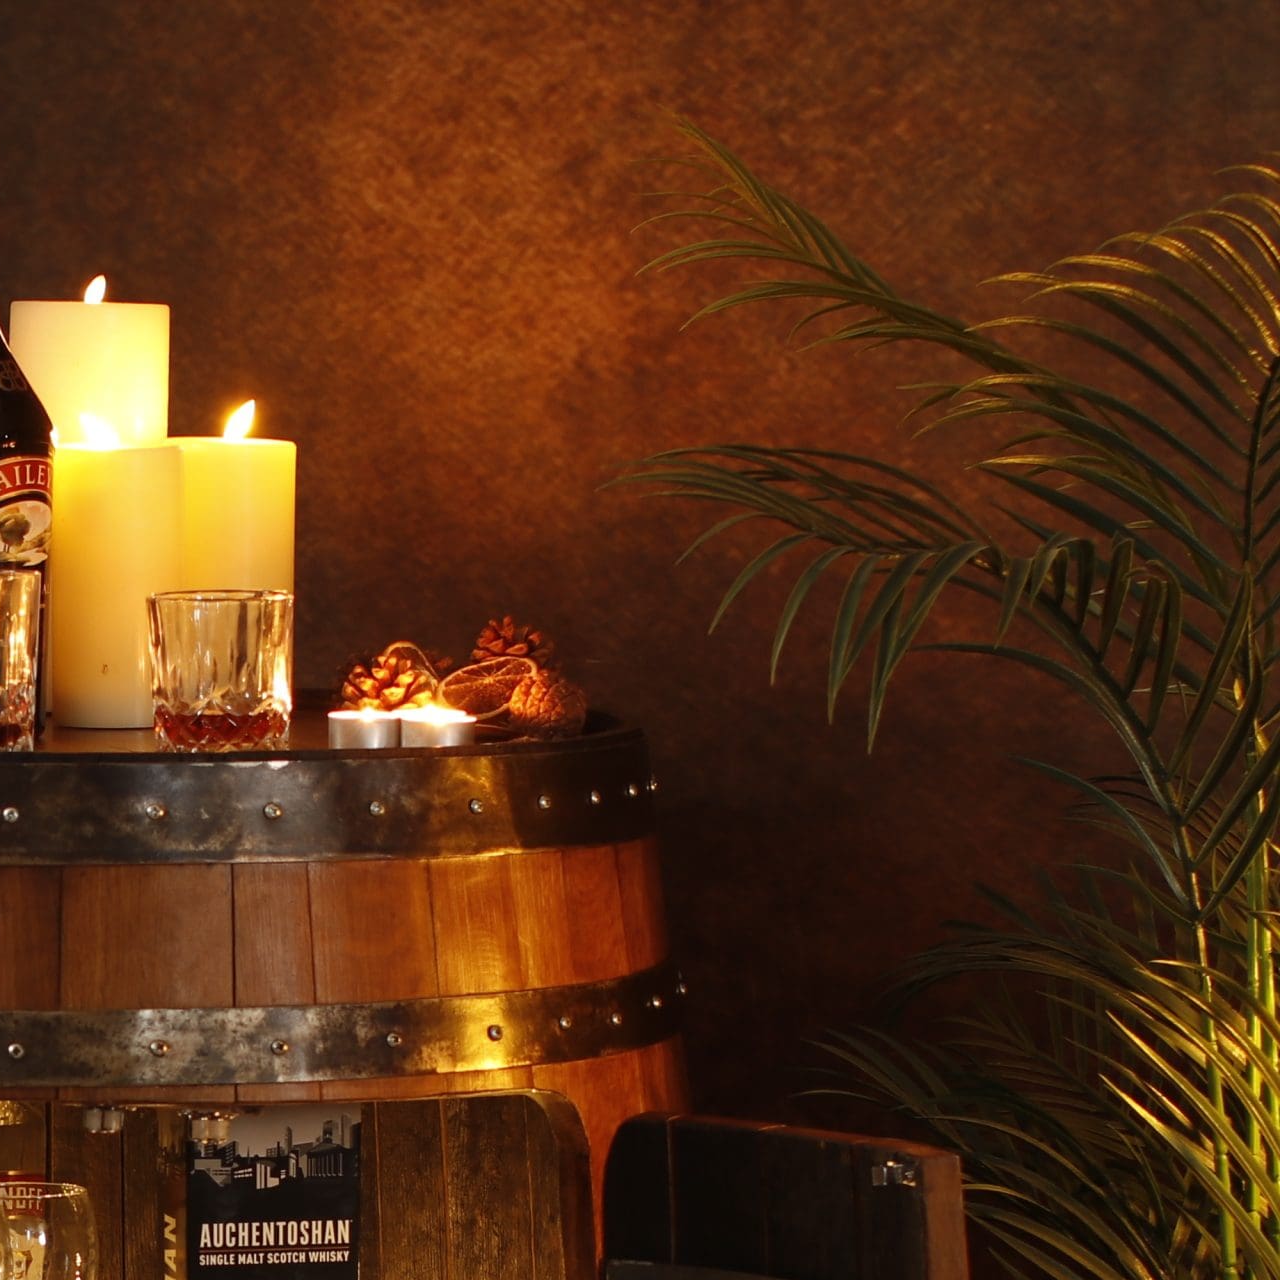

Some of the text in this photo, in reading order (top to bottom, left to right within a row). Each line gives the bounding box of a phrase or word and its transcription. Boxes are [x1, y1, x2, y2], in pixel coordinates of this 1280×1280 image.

[199, 1219, 350, 1248] AUCHENTOSHAN
[199, 1251, 350, 1266] SINGLE MALT SCOTCH WHISKY
